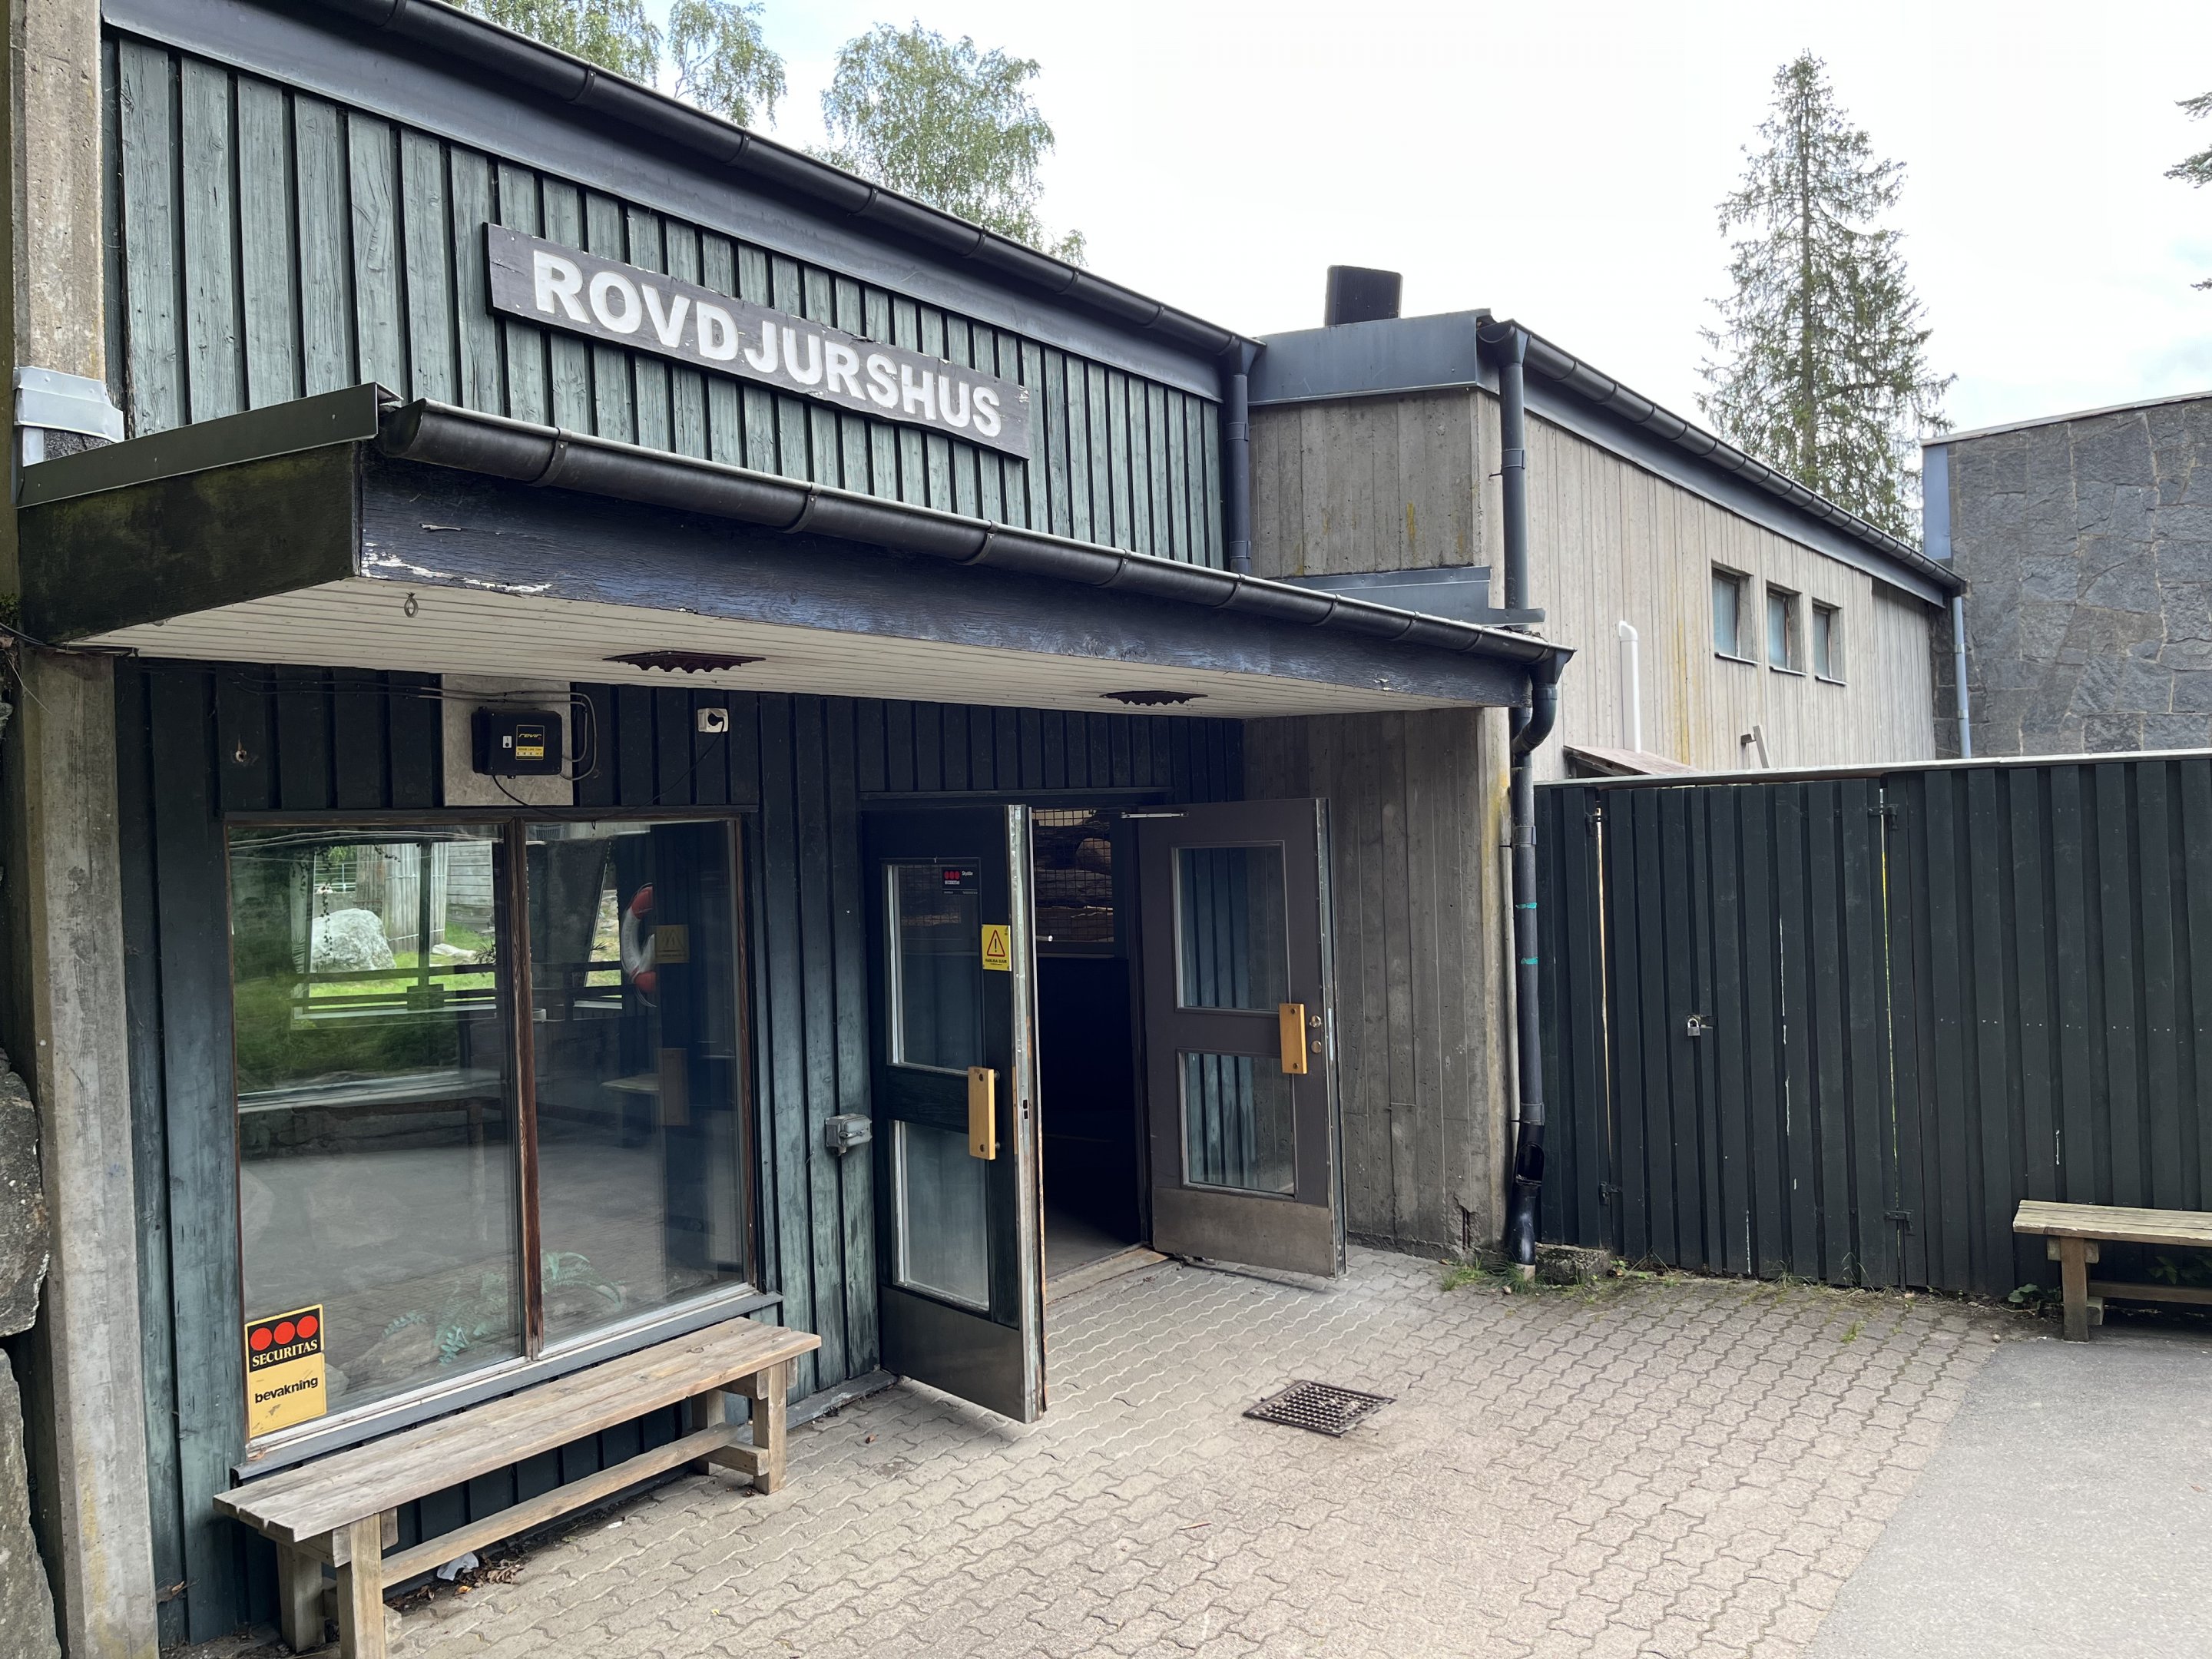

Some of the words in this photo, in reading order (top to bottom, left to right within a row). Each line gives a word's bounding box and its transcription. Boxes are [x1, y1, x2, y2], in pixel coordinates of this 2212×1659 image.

[533, 249, 1002, 438] ROVDJURSHUS
[252, 1339, 318, 1367] SECURITAS
[255, 1377, 318, 1403] bevakning
